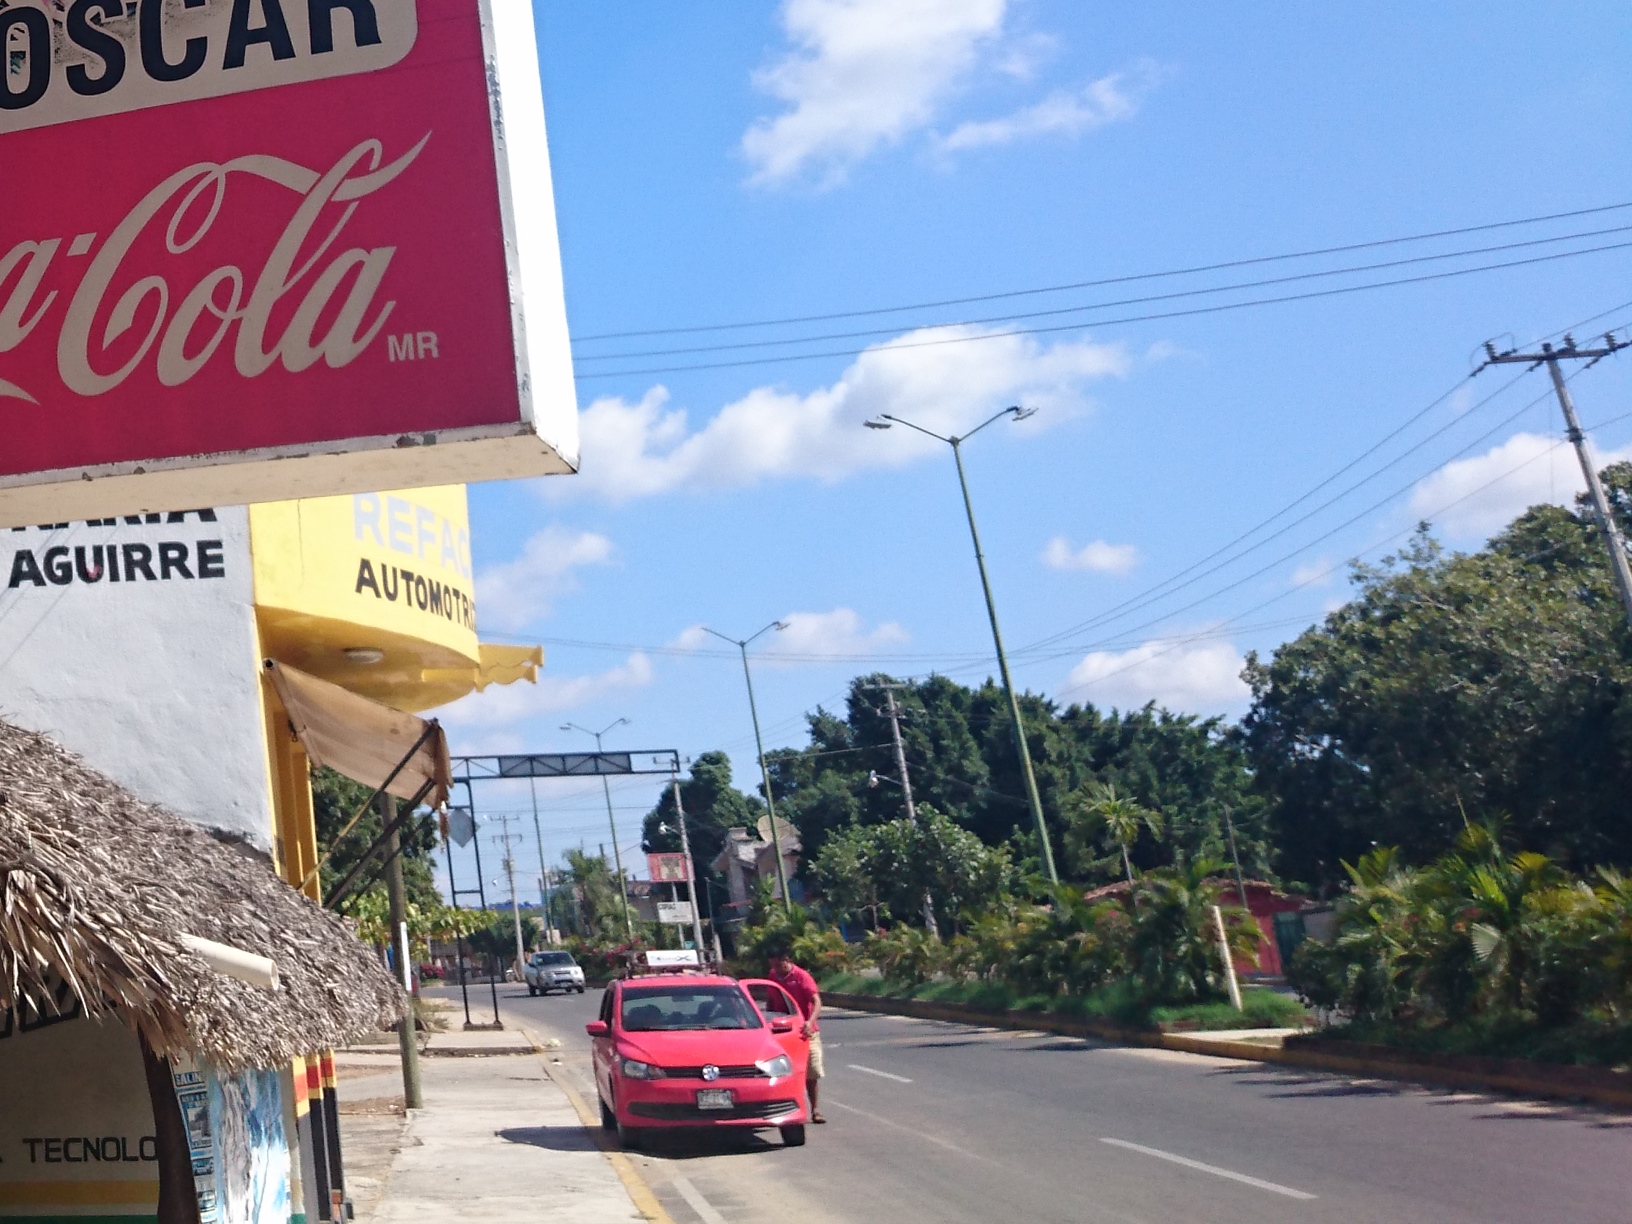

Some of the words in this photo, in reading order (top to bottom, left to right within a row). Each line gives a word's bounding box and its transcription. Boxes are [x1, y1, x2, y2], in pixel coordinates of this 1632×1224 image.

[388, 331, 440, 363] MR
[8, 539, 225, 589] AGUIRRE
[22, 1135, 158, 1164] TECNOLO
